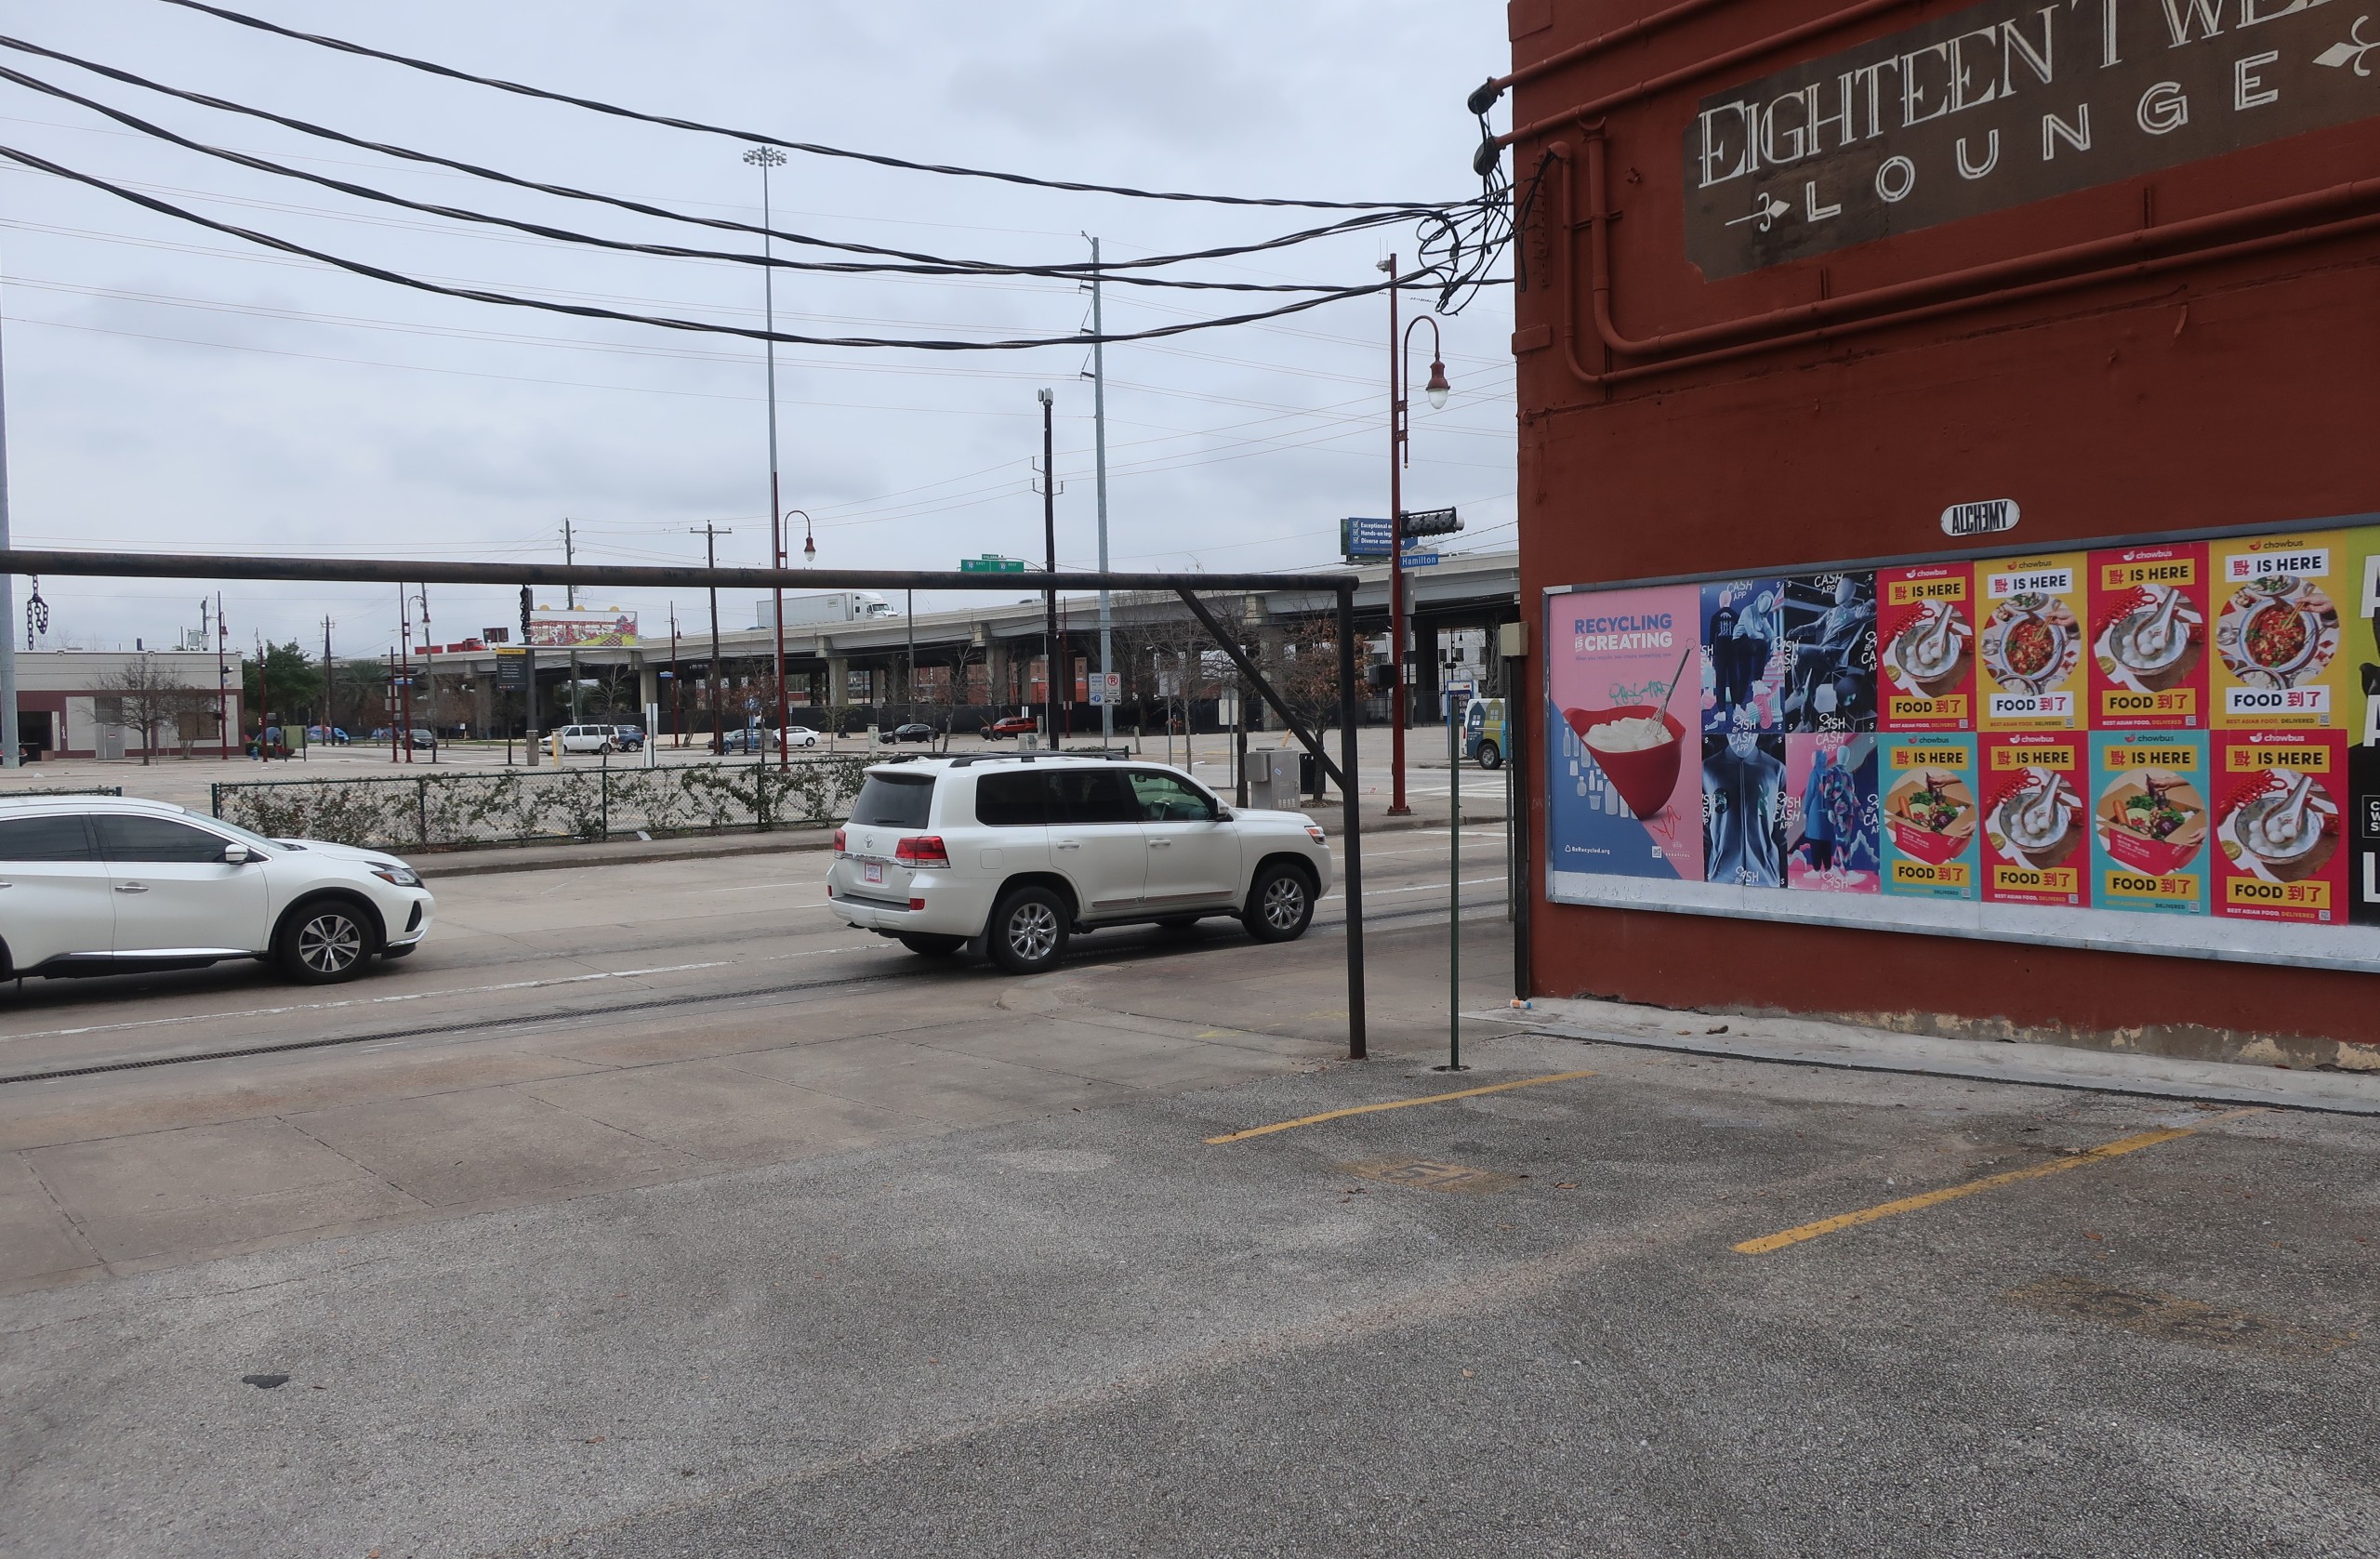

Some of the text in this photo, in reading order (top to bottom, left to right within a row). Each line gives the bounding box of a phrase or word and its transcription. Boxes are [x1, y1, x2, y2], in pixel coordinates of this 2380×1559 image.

[1698, 4, 2059, 189] EIGHTEEN
[1807, 50, 2279, 223] LOUNGE
[2264, 539, 2303, 549] chowbus
[1402, 556, 1436, 565] Hamilton
[2136, 549, 2173, 559] chowbus
[2019, 560, 2052, 569] chowbus
[2257, 560, 2272, 573] IS
[2277, 556, 2321, 571] HERE
[2131, 568, 2144, 581] IS
[2149, 565, 2188, 579] HERE
[2014, 576, 2028, 589] IS
[2030, 575, 2067, 588] HERE
[1733, 591, 1747, 601] APP
[1821, 585, 1835, 595] APP
[1912, 587, 1924, 597] IS
[1927, 583, 1961, 596] HERE
[1575, 614, 1673, 634] RECYCLING
[1585, 631, 1673, 651] CREATING
[1896, 699, 1961, 713] FOOD 到了
[1997, 697, 2067, 711] FOOD 到了
[2109, 694, 2188, 709] FOOD 到了
[2234, 692, 2321, 707] FOOD 到了
[2137, 733, 2174, 742] chowbus
[2264, 733, 2305, 742] chowbus
[1914, 752, 1925, 763] IS
[1929, 752, 1964, 763] HERE
[2016, 752, 2030, 763] IS
[2033, 751, 2069, 763] HERE
[2132, 752, 2146, 764] IS
[2150, 751, 2190, 764] HERE
[2257, 752, 2272, 764] IS
[2278, 751, 2322, 765] HERE
[1779, 821, 1793, 829] APP
[1898, 866, 1964, 881] FOOD 到了
[2001, 872, 2070, 888] FOOD 到了
[2112, 878, 2191, 894] FOOD 到了
[2235, 884, 2321, 902] FOOD 到了
